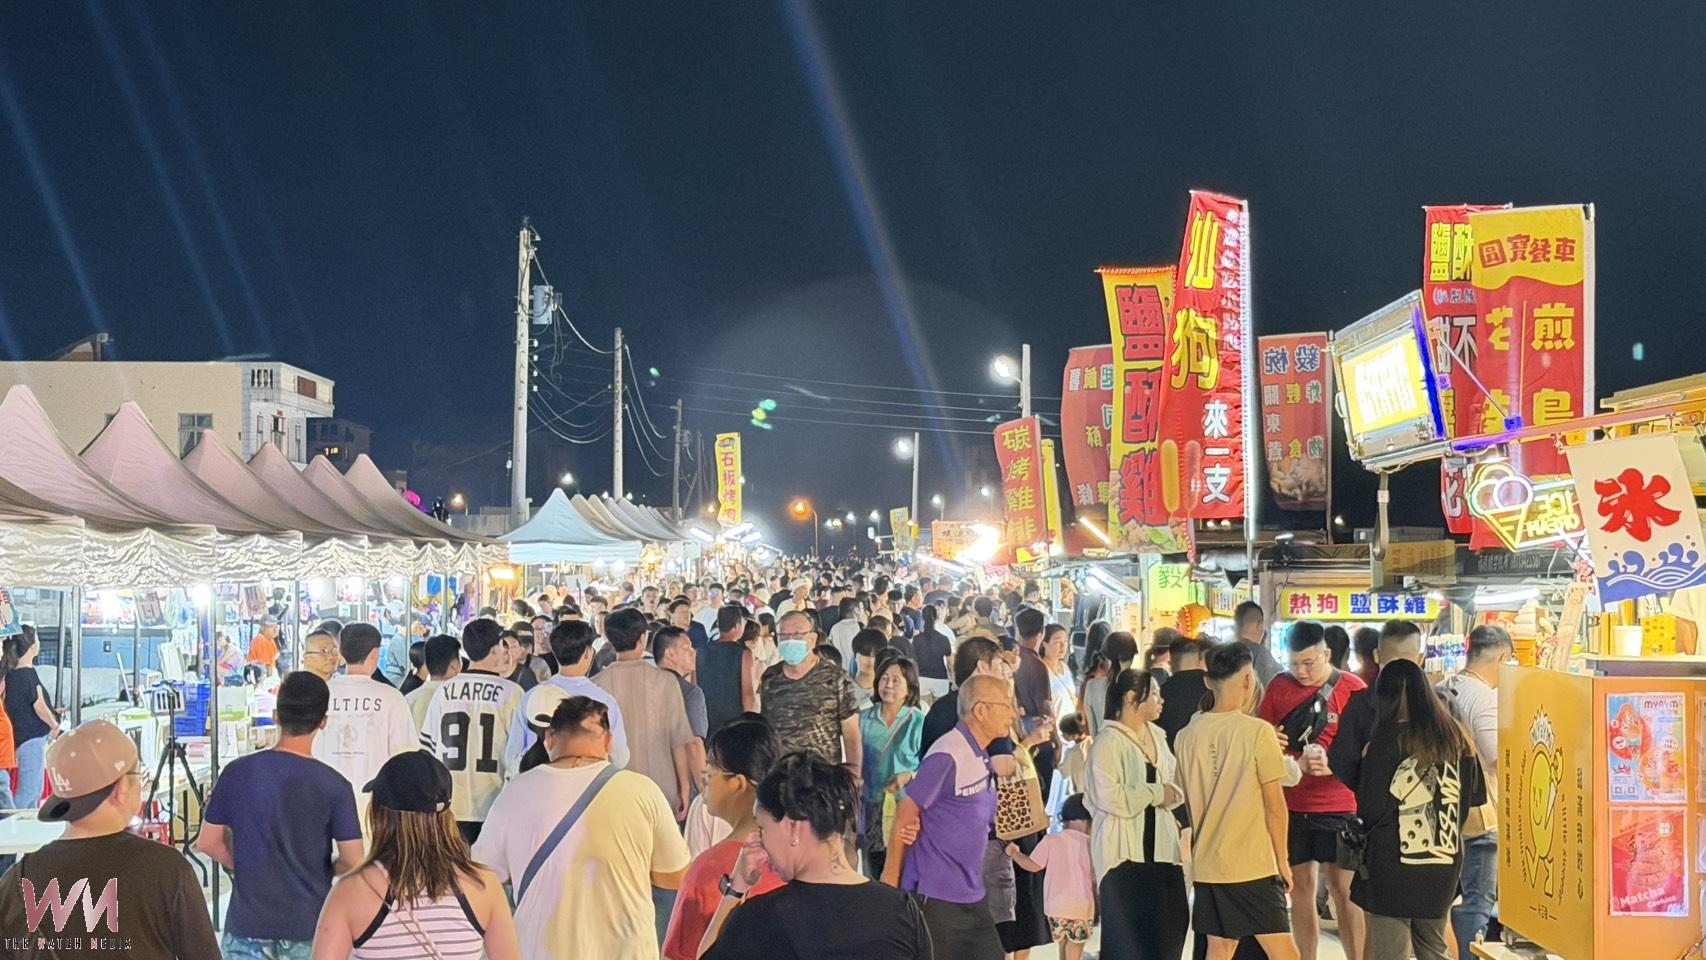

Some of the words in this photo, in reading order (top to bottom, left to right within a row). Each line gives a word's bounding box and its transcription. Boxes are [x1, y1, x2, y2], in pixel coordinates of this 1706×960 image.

[1478, 234, 1577, 268] 圓寶餐車
[1202, 399, 1231, 505] 來一支
[1002, 425, 1037, 541] 碳烤雞排
[1289, 593, 1339, 614] 熱狗
[333, 697, 382, 712] LTICS
[440, 711, 499, 773] 91
[1620, 887, 1665, 907] Matcha
